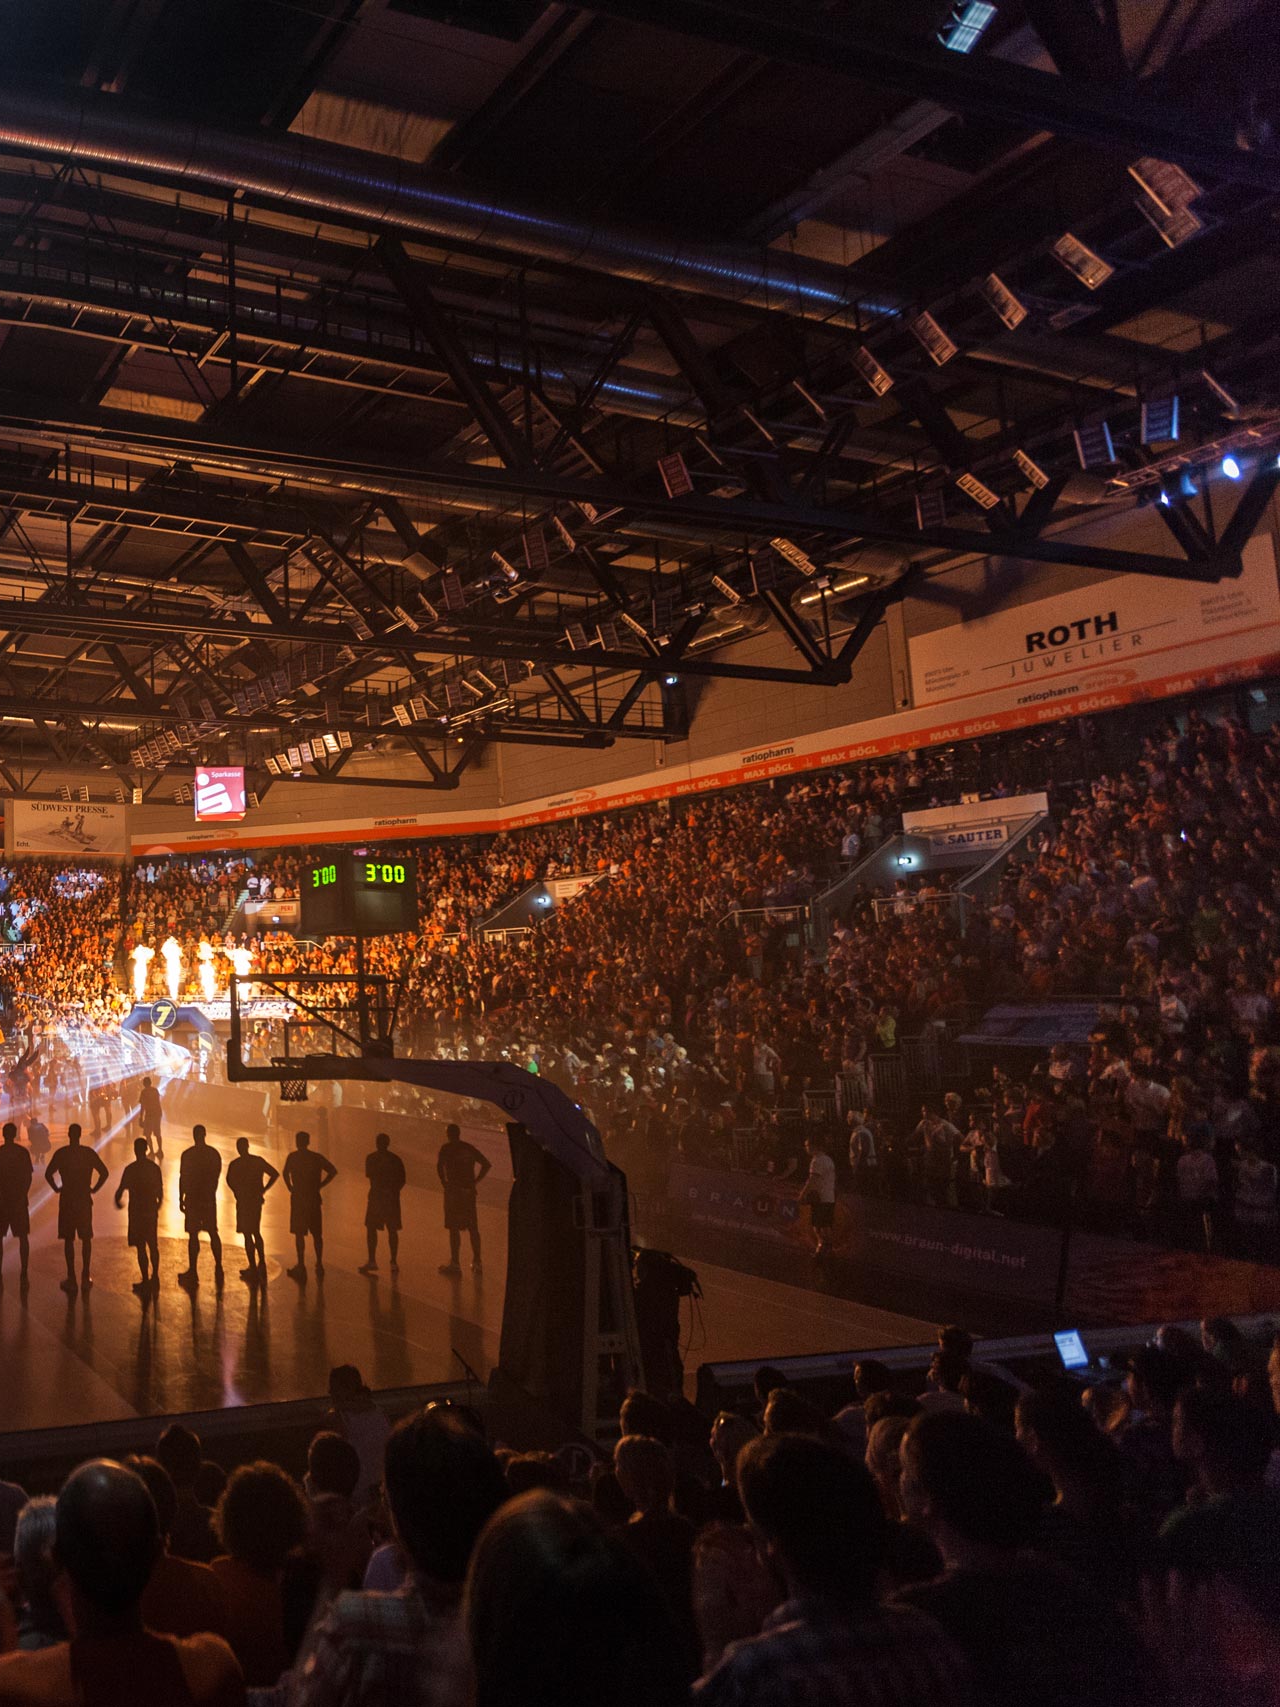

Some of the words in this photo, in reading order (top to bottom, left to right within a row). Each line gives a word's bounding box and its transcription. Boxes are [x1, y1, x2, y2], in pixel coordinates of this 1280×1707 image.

[1025, 611, 1118, 654] ROTH
[1010, 634, 1144, 678] JUWELIER
[1018, 684, 1079, 704] ratiopharm
[1038, 703, 1073, 720] MAX
[1078, 695, 1120, 713] BÖGL
[929, 728, 960, 742] MAX
[963, 720, 1000, 735] BÖGL
[742, 746, 794, 764] ratiopharm
[821, 753, 846, 764] MAX
[849, 745, 879, 758] BÖGL
[743, 769, 766, 779] MAX
[768, 763, 794, 775] BÖGL
[676, 782, 696, 793] MAX
[698, 777, 720, 788] BÖGL
[31, 801, 72, 812] SÜDWEST
[75, 805, 109, 814] PRESSE
[374, 816, 417, 827] ratiopharm
[186, 832, 215, 841] ratiopharm
[948, 829, 1002, 845] SAUTER
[156, 1005, 172, 1026] 7
[687, 1188, 796, 1218] BRAUN
[870, 1228, 1026, 1269] www.braun-digital.net
